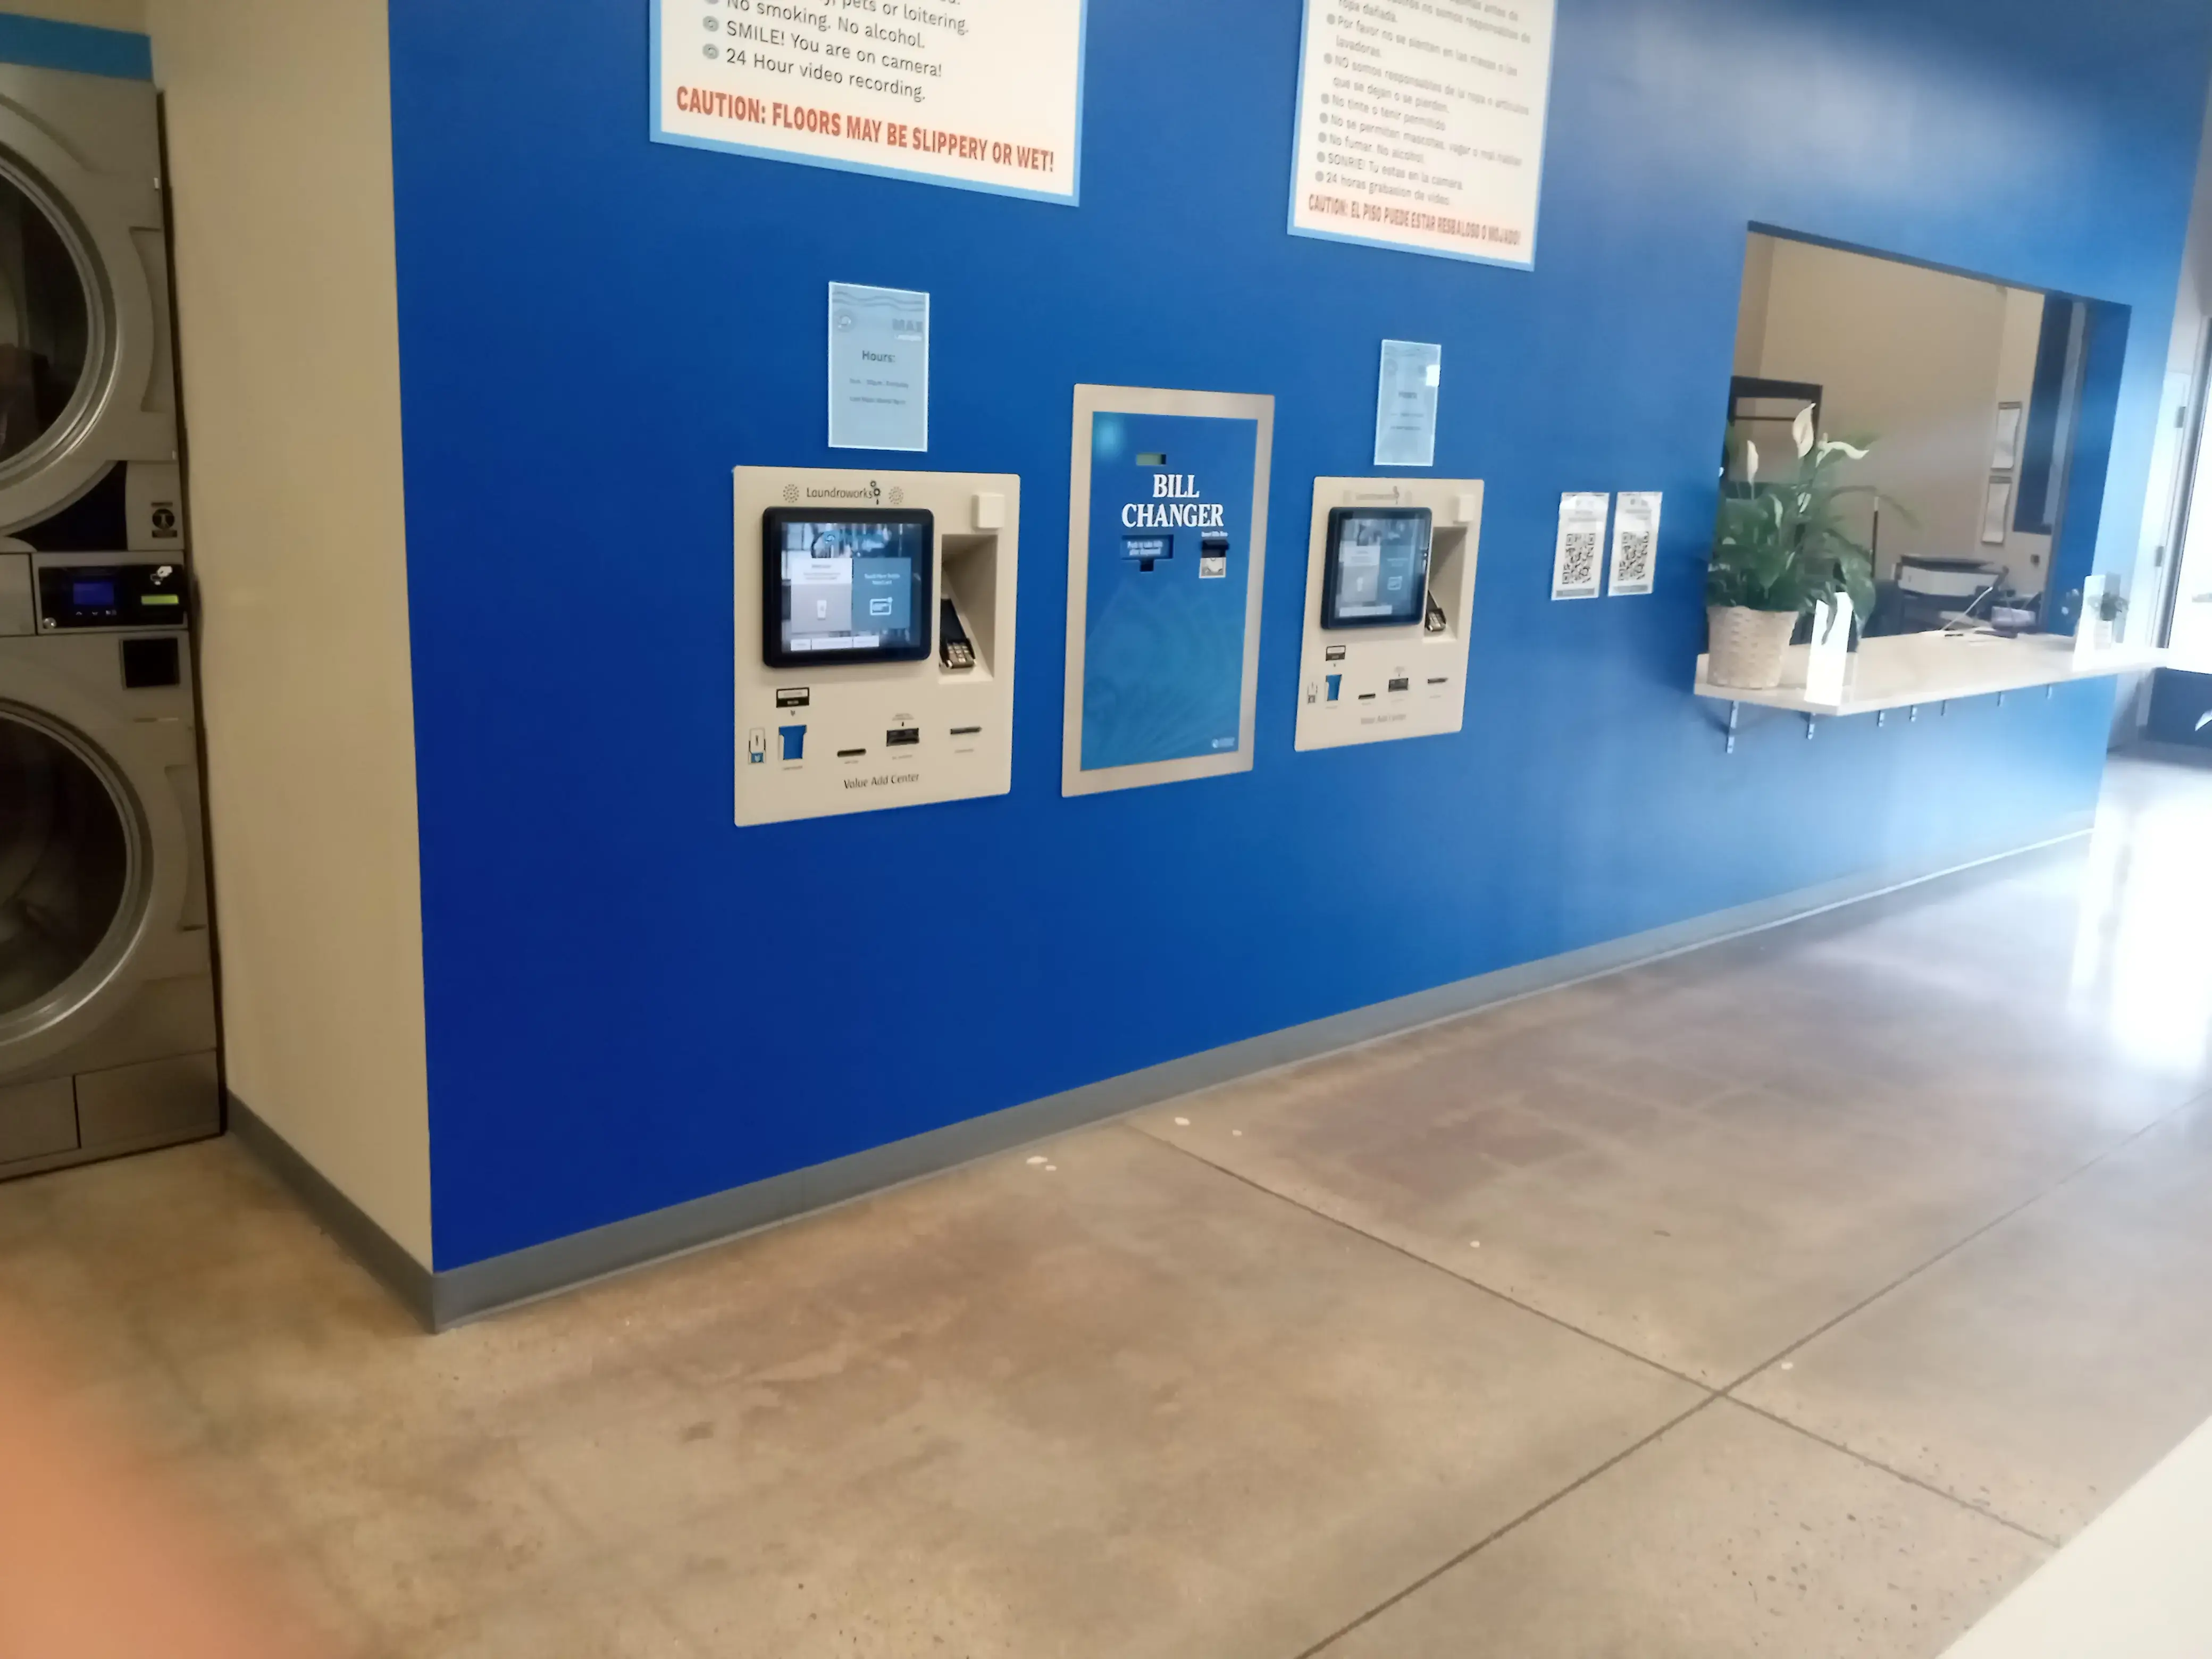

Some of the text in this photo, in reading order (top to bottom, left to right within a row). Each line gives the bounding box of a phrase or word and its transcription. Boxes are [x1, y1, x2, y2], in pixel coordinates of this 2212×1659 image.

[727, 0, 925, 49] No smoking. No alcohol.
[882, 3, 899, 16] or
[903, 3, 969, 36] loitering.
[726, 20, 942, 78] SMILE! You are on camera!
[1335, 55, 1350, 69] NO
[726, 47, 926, 103] 24 Hour video recording.
[676, 86, 1054, 173] CAUTION: FLOORS MAY BE SLIPPERY OR WET!
[1326, 172, 1338, 184] 24
[861, 349, 896, 363] Hours:
[806, 486, 873, 499] Laundroworks
[1152, 474, 1200, 499] BILL
[1121, 503, 1225, 528] CHANGER
[843, 774, 919, 790] Value Add Center
